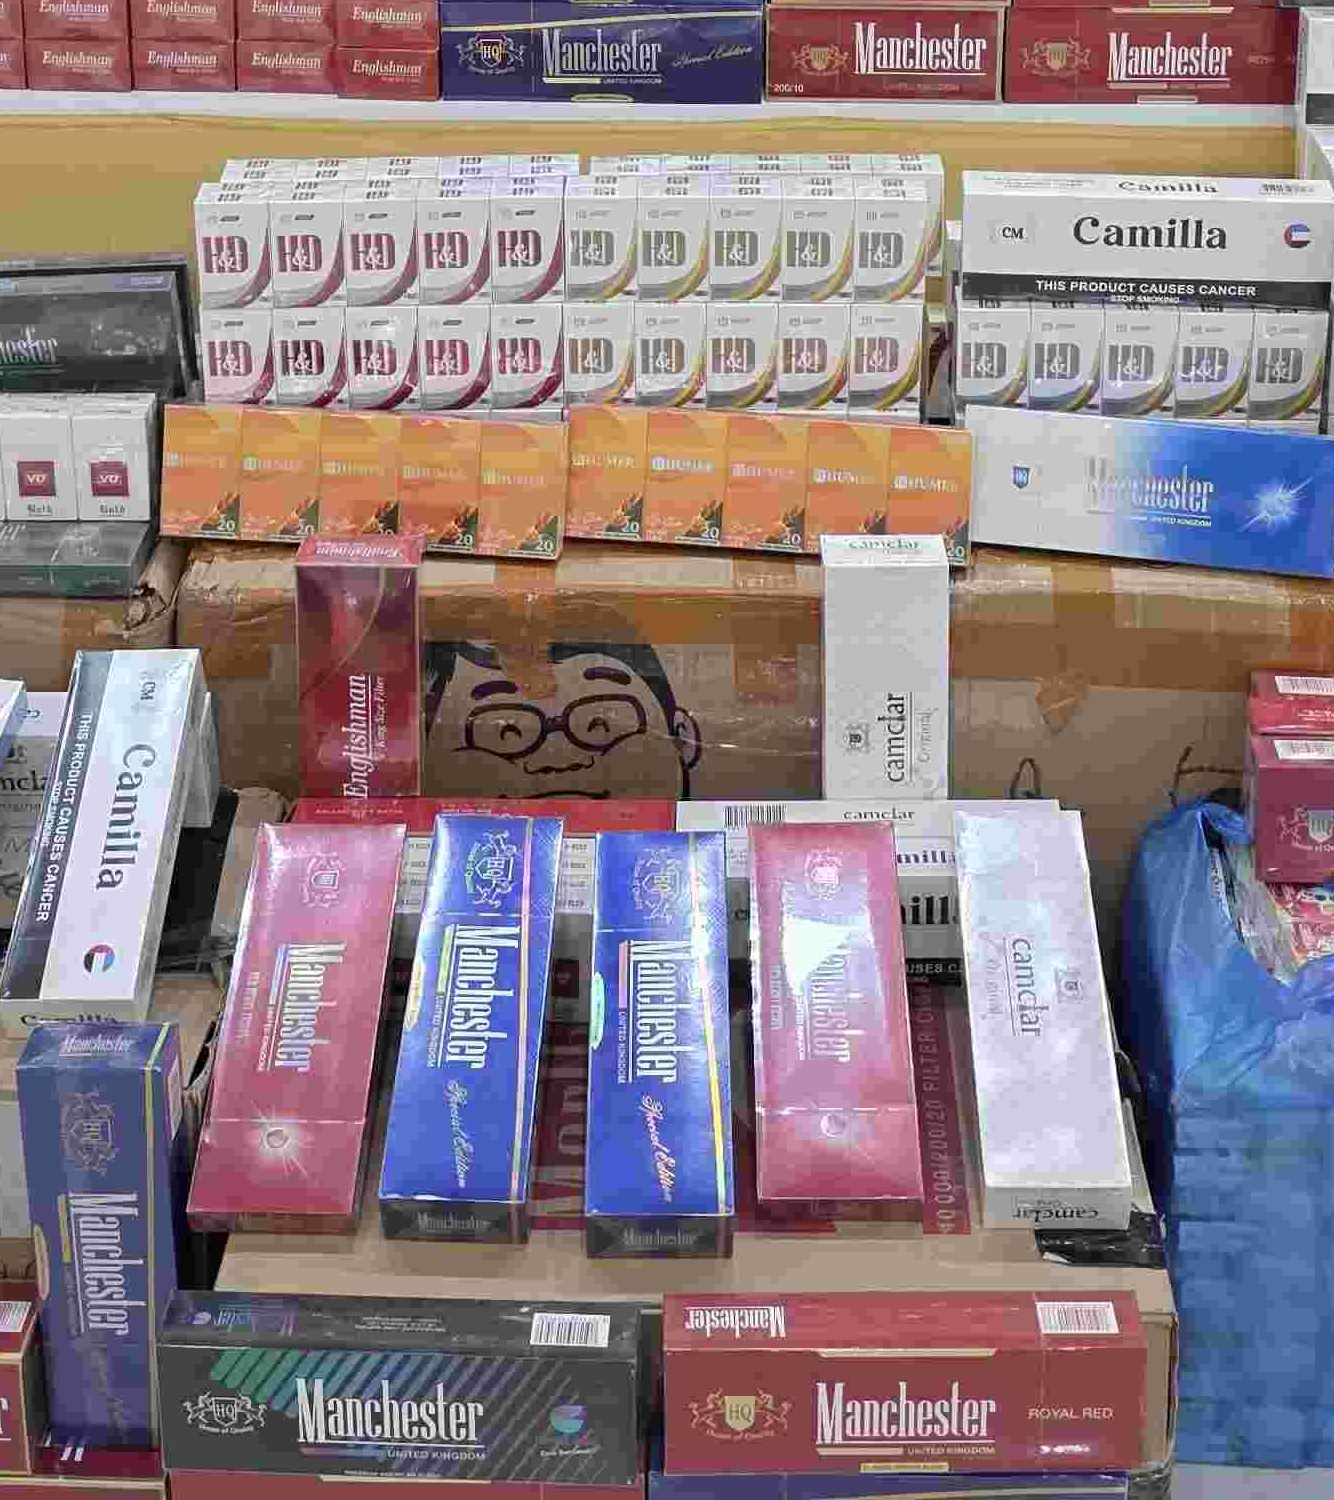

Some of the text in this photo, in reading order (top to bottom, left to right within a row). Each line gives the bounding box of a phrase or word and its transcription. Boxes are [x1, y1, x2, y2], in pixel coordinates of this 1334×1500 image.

[42, 51, 113, 68] Englishman
[541, 26, 663, 76] Manchester
[1107, 31, 1233, 83] Manchester
[1117, 180, 1218, 194] Camilla
[1002, 216, 1227, 249] CM Camilla
[1035, 280, 1257, 297] THIS PRODUCT CAUSES CANCER
[343, 674, 368, 798] Englishman
[886, 692, 909, 783] camclar
[63, 742, 87, 804] PRODUCT
[51, 807, 73, 862] CAUSES
[96, 743, 157, 890] Camilla
[843, 806, 916, 822] camclar
[35, 861, 61, 923] CANCER
[634, 940, 702, 1084] Manchester
[1010, 938, 1049, 1037] camclar
[921, 1031, 941, 1092] FILTER
[68, 1191, 148, 1336] Manchester
[683, 1305, 787, 1339] Manchester
[213, 1378, 485, 1444] HQ Manchester
[728, 1380, 1114, 1445] HQ Manchester ROYAL RED
[386, 1448, 486, 1461] UNITED KINGDOM
[907, 1446, 996, 1455] UNITED KINGDOM
